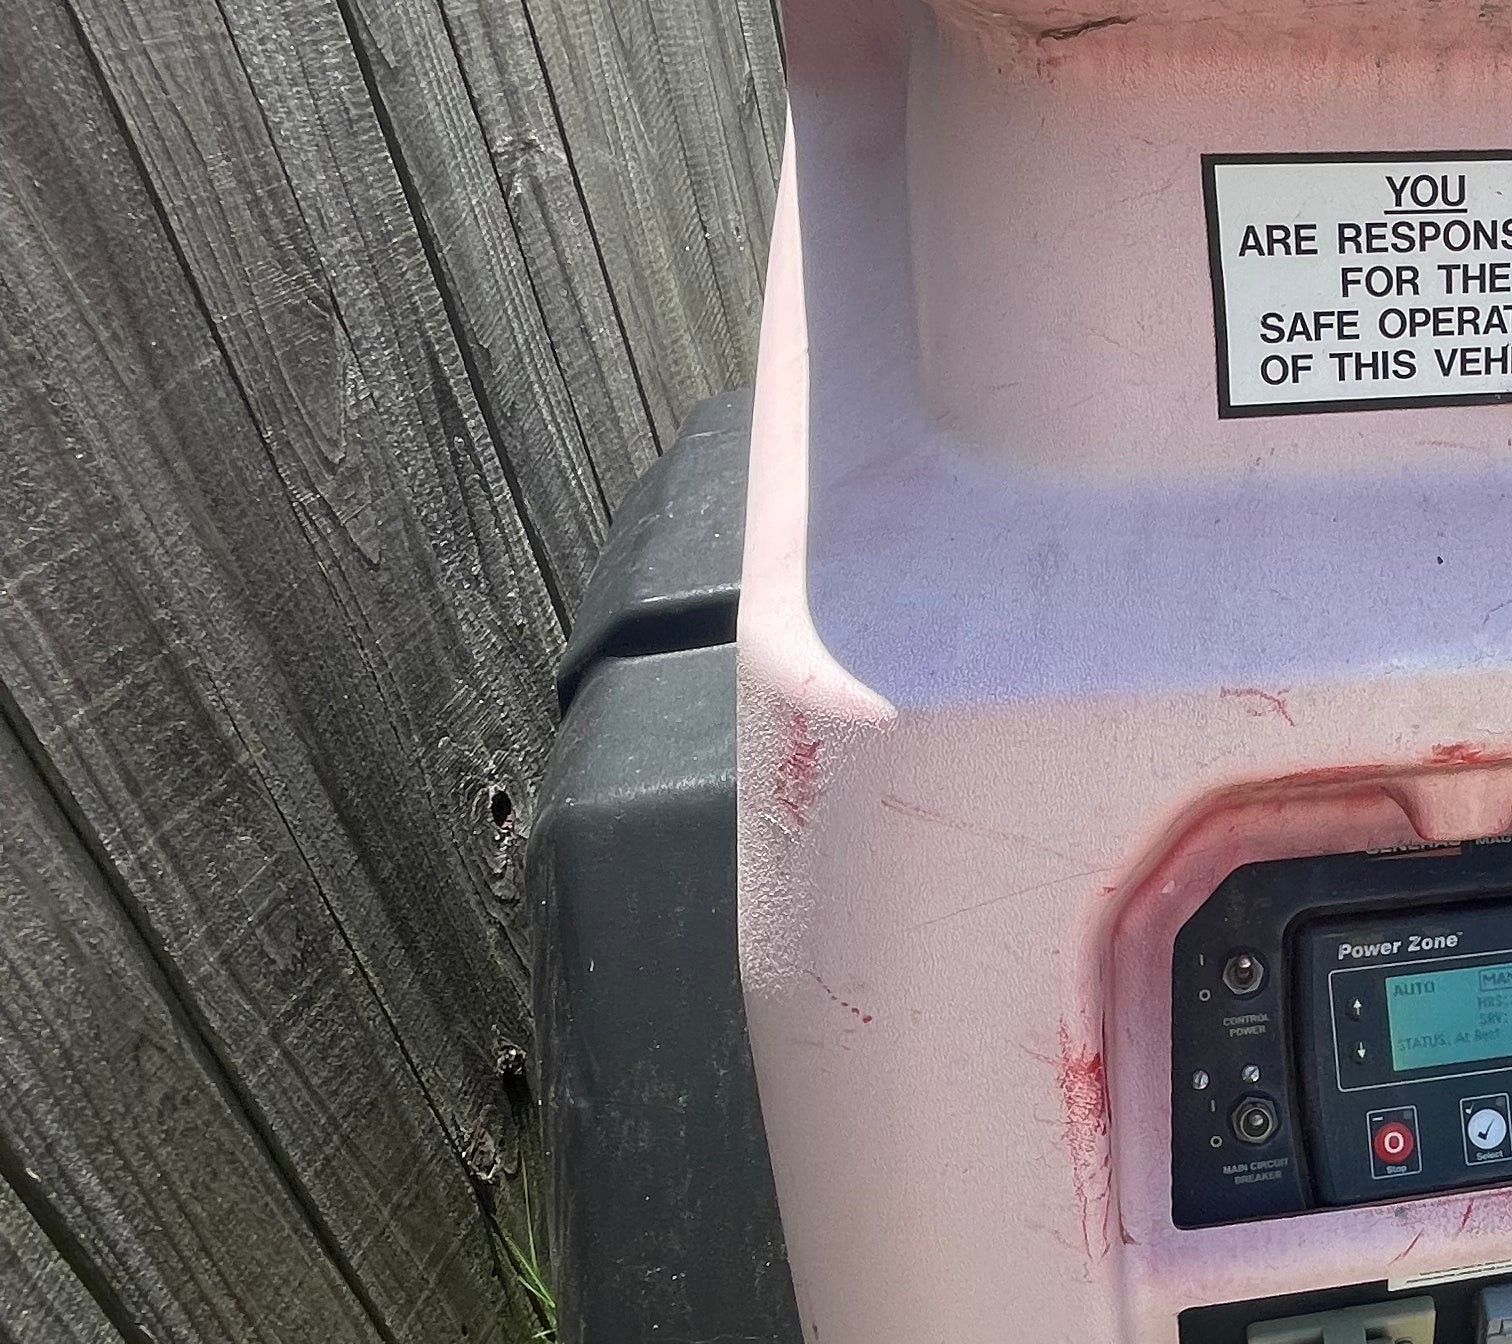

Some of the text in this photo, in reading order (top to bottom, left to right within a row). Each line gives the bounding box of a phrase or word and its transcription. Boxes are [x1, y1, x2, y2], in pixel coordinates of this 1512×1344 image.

[1385, 173, 1467, 208] YOU
[1238, 223, 1318, 257] ARE
[1341, 262, 1511, 298] FOR THE
[1260, 309, 1360, 343] SAFE
[1260, 355, 1317, 386] OF
[1329, 348, 1416, 382] THIS
[1338, 934, 1459, 960] Power Zone
[1392, 981, 1435, 996] AUTO
[1223, 1014, 1269, 1026] CONTROL
[1229, 1025, 1266, 1037] POWER
[1222, 1157, 1289, 1175] MAIN CIRCUIT
[1234, 1170, 1282, 1185] BREAKER
